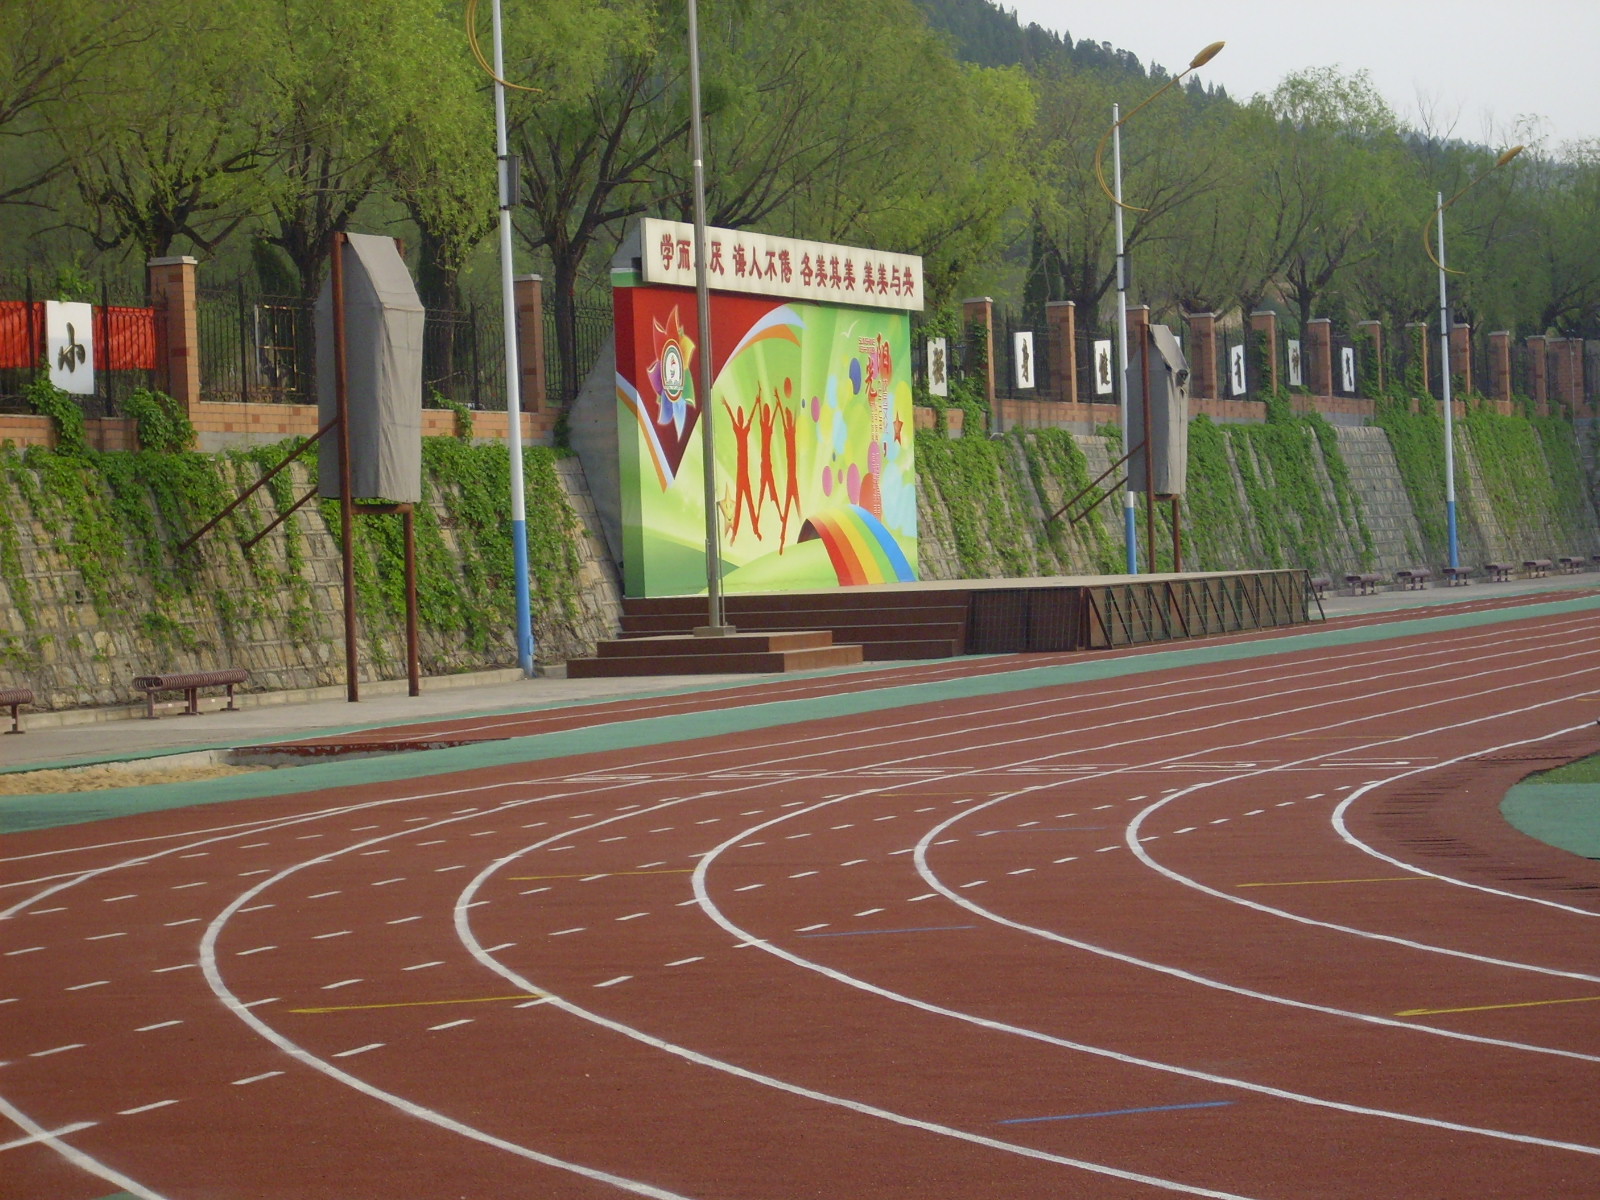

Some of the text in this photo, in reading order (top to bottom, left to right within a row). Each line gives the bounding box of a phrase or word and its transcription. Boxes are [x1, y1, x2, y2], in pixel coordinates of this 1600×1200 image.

[660, 233, 725, 276] 学而厌
[799, 252, 856, 291] 各美其美
[863, 261, 914, 297] 美美与共
[57, 321, 86, 373] 小
